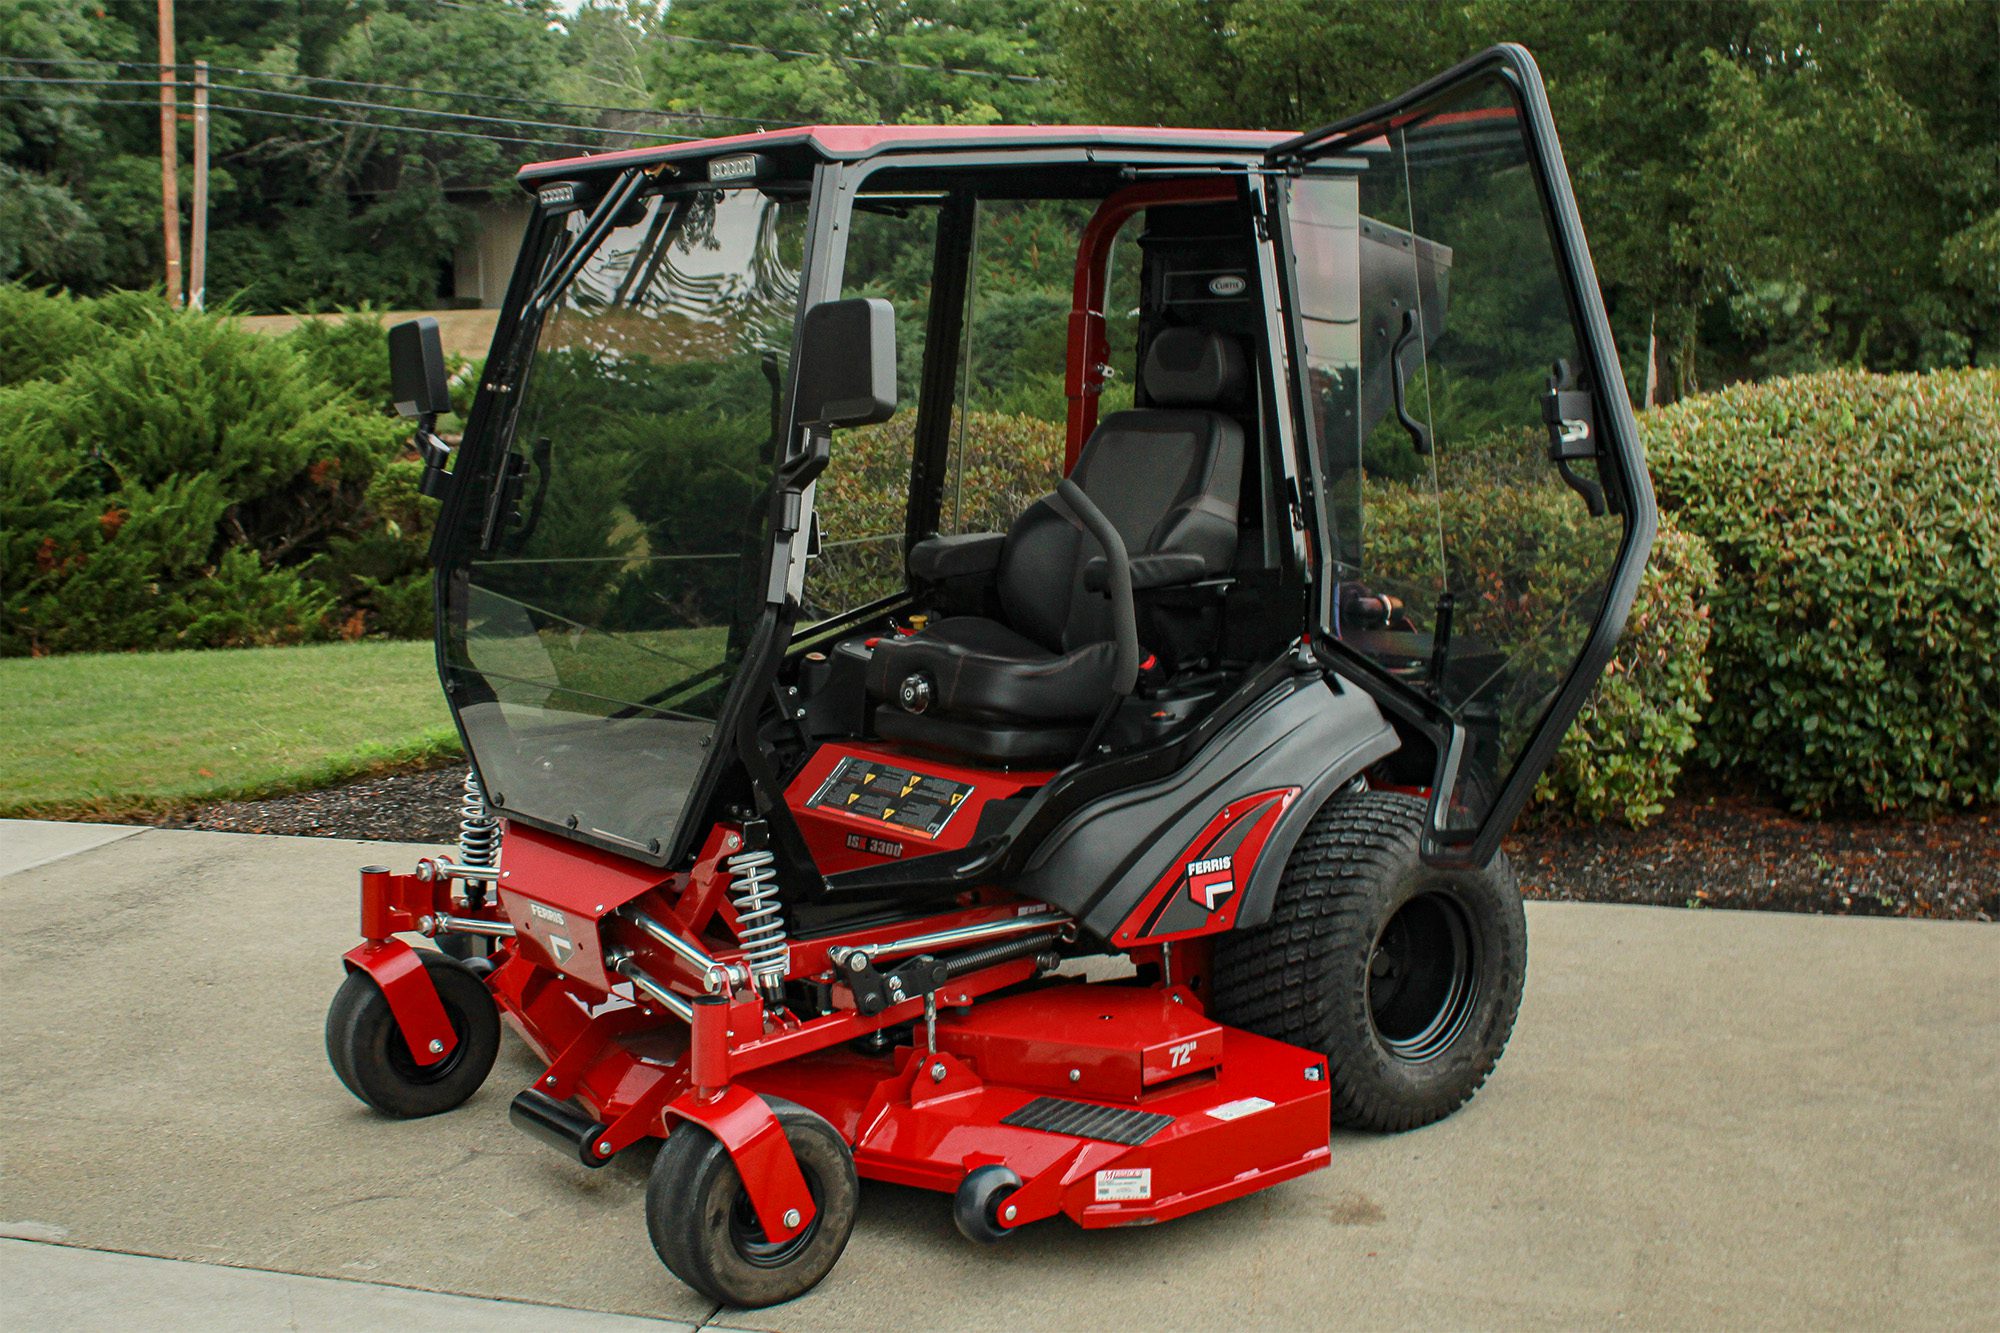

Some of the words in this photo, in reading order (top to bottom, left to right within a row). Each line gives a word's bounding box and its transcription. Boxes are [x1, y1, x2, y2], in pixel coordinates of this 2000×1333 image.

[869, 839, 901, 857] 3300
[1188, 856, 1231, 876] FERRIS
[530, 903, 564, 925] FERRIS
[1169, 1041, 1197, 1068] 72"
